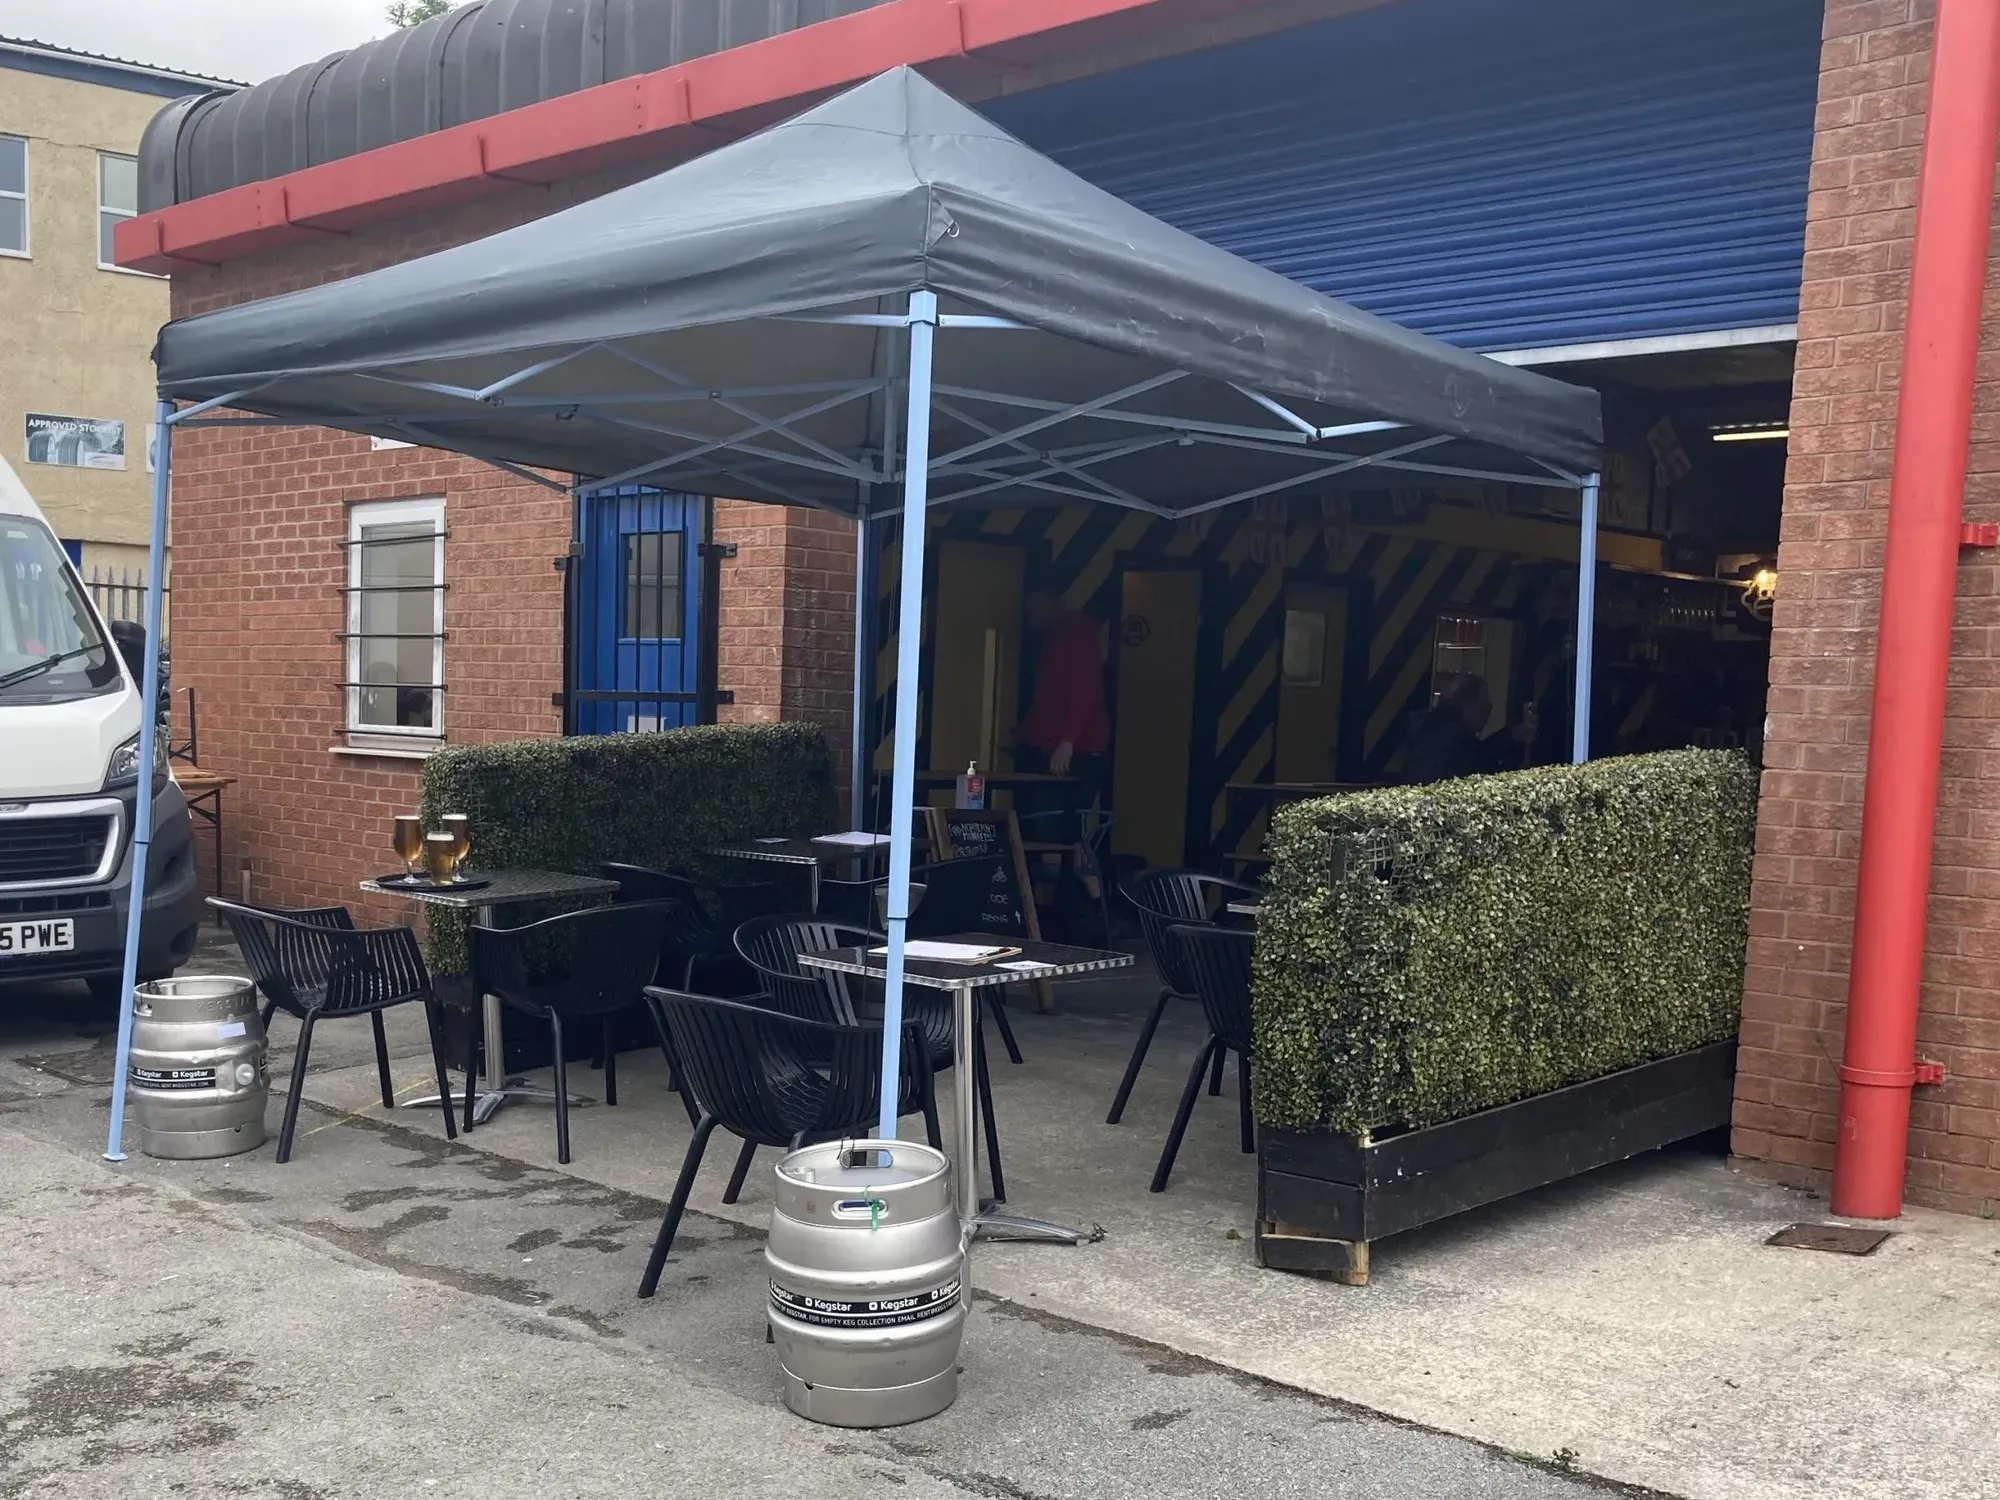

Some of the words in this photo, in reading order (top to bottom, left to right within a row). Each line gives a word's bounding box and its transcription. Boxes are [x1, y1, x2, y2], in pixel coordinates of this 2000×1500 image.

[28, 419, 77, 431] APPROVED
[79, 423, 122, 435] STOCKIST
[21, 923, 68, 949] PWE
[141, 1069, 162, 1078] Kegstar
[180, 1069, 209, 1078] Kegstar
[774, 1283, 794, 1301] Kegstar
[814, 1299, 852, 1312] Kegstar
[880, 1297, 919, 1311] Kegstar
[939, 1280, 959, 1297] Kegsta
[809, 1314, 820, 1323] FOR
[821, 1317, 841, 1325] EMPTY
[857, 1317, 896, 1326] COLLECTION
[897, 1314, 915, 1322] EMAIL
